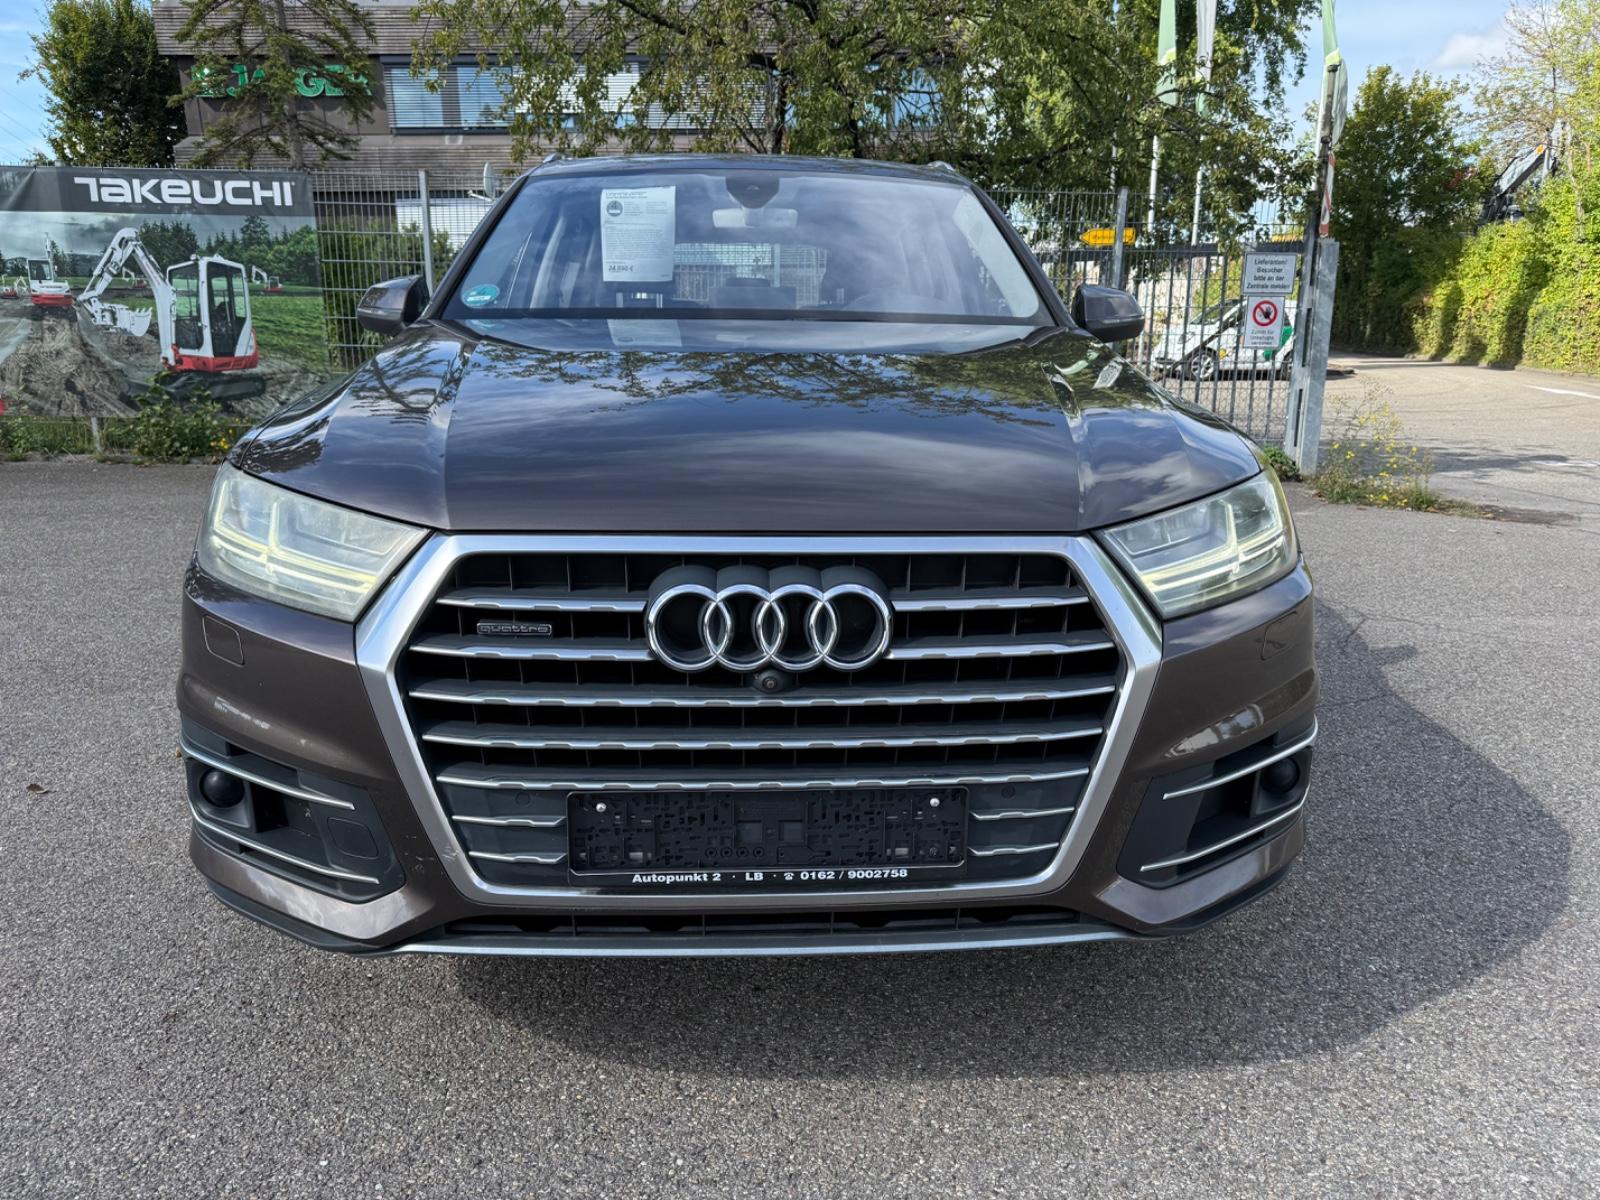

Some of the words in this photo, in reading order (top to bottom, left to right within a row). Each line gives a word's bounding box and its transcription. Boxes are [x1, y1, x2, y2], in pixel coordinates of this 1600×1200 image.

[74, 176, 294, 206] TAKEUCHI
[480, 624, 549, 634] quattro
[632, 872, 709, 884] Autopunkt
[712, 872, 721, 882] 2
[745, 872, 764, 881] LB
[800, 871, 836, 881] 0162
[847, 868, 909, 879] 9002758
